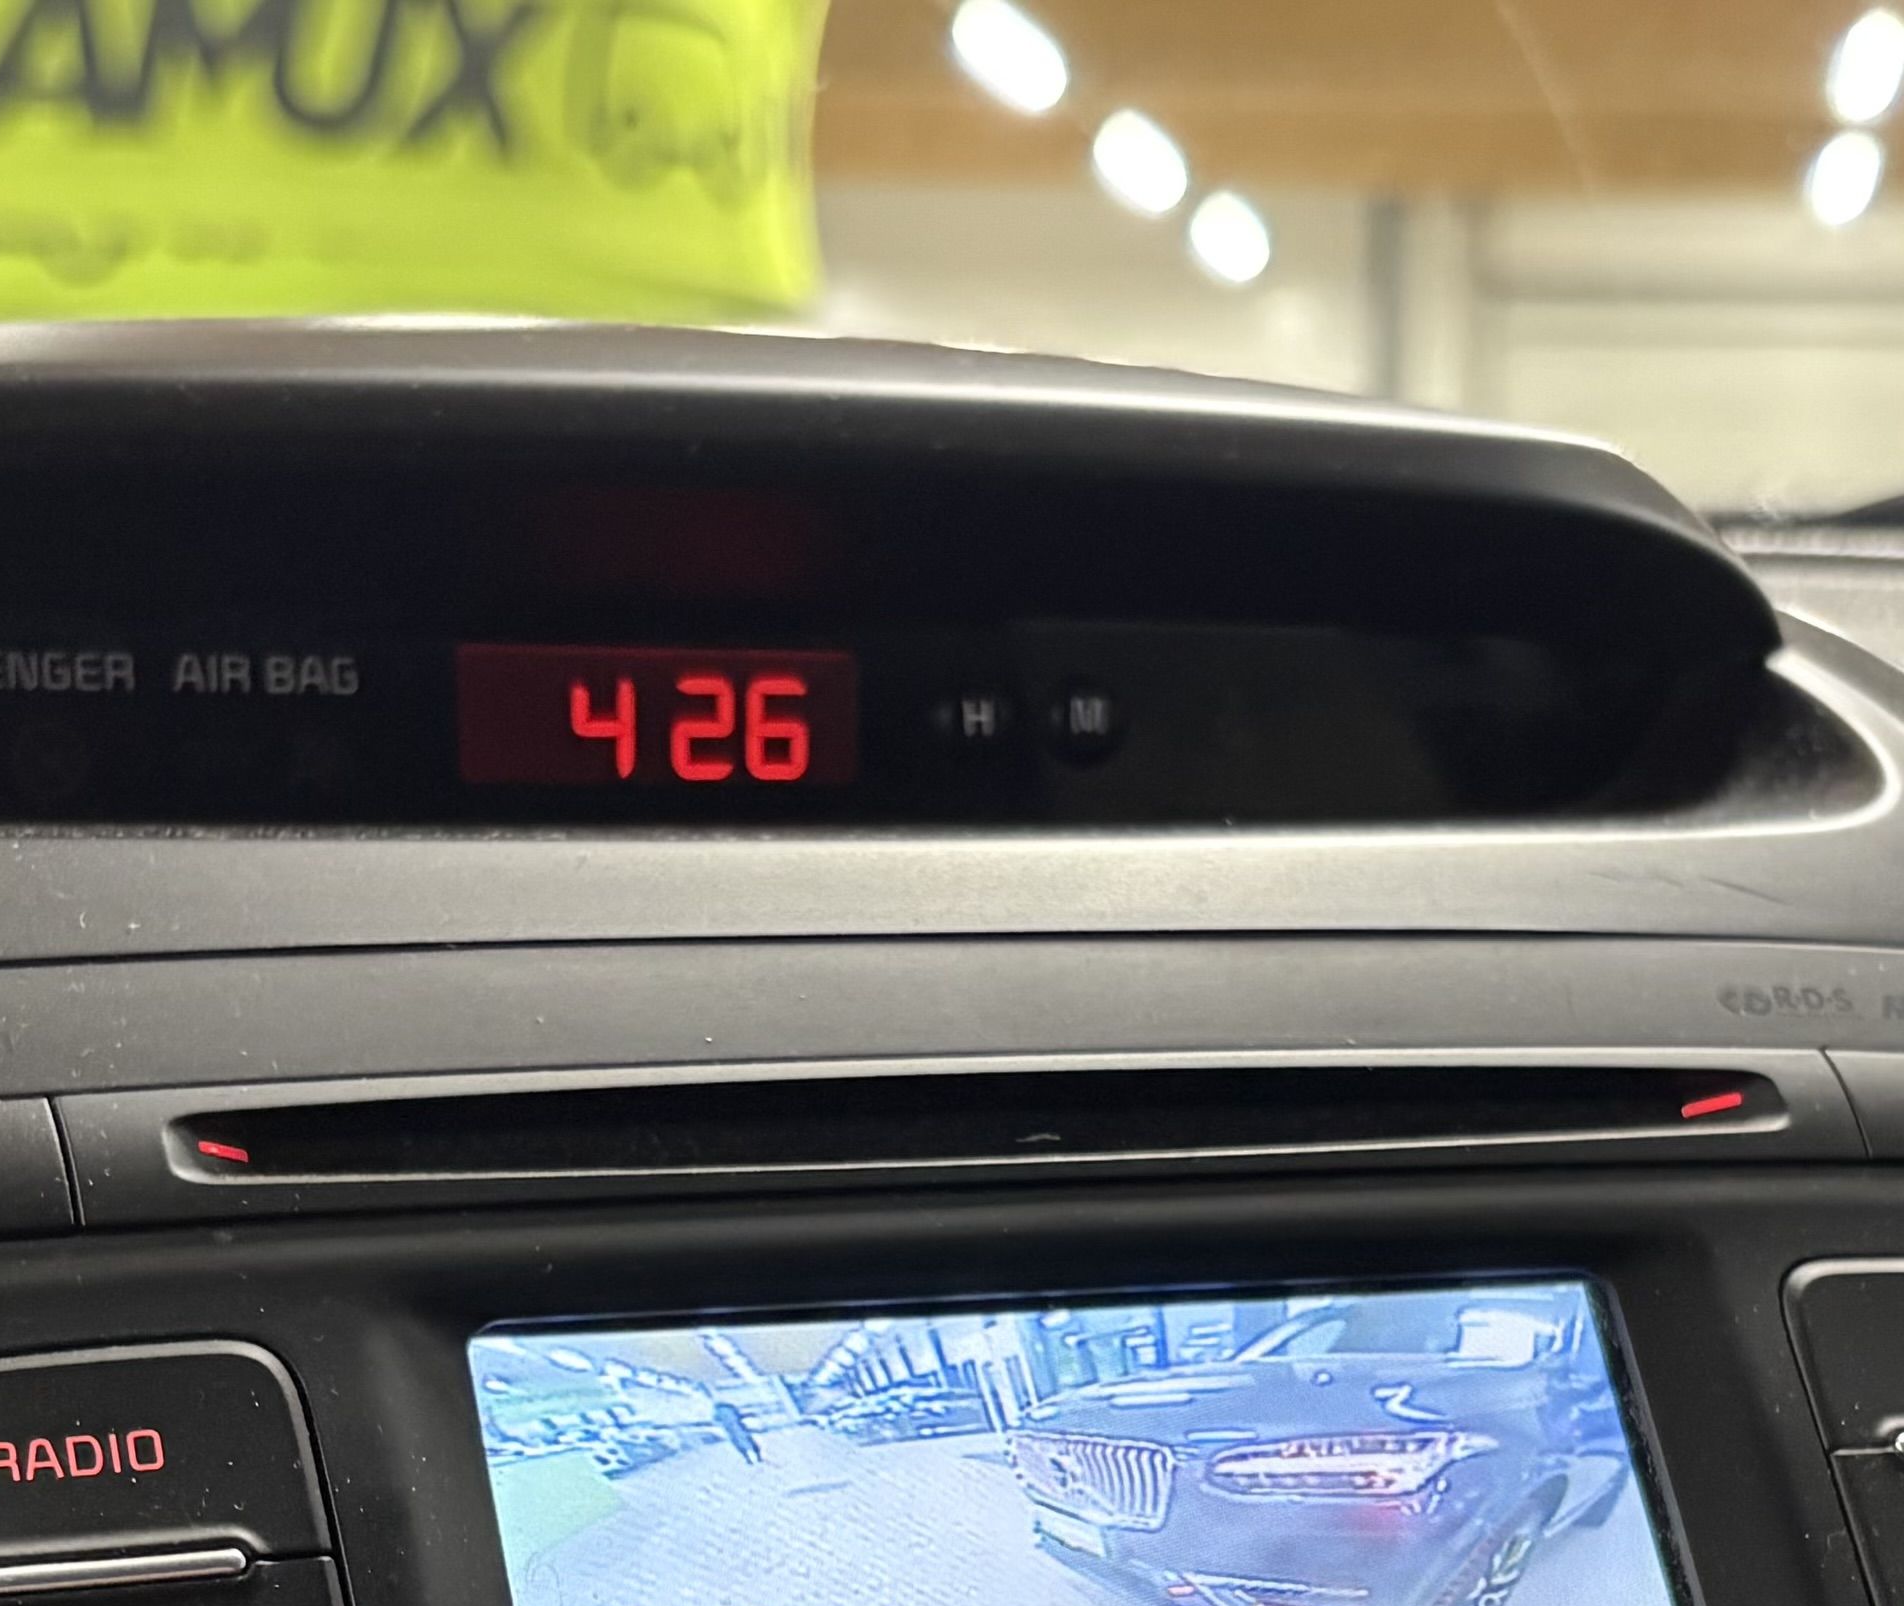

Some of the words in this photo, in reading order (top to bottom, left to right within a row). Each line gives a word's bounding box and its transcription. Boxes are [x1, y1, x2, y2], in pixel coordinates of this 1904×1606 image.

[172, 653, 252, 693] AIR
[264, 655, 359, 696] BAG
[961, 699, 995, 736] H
